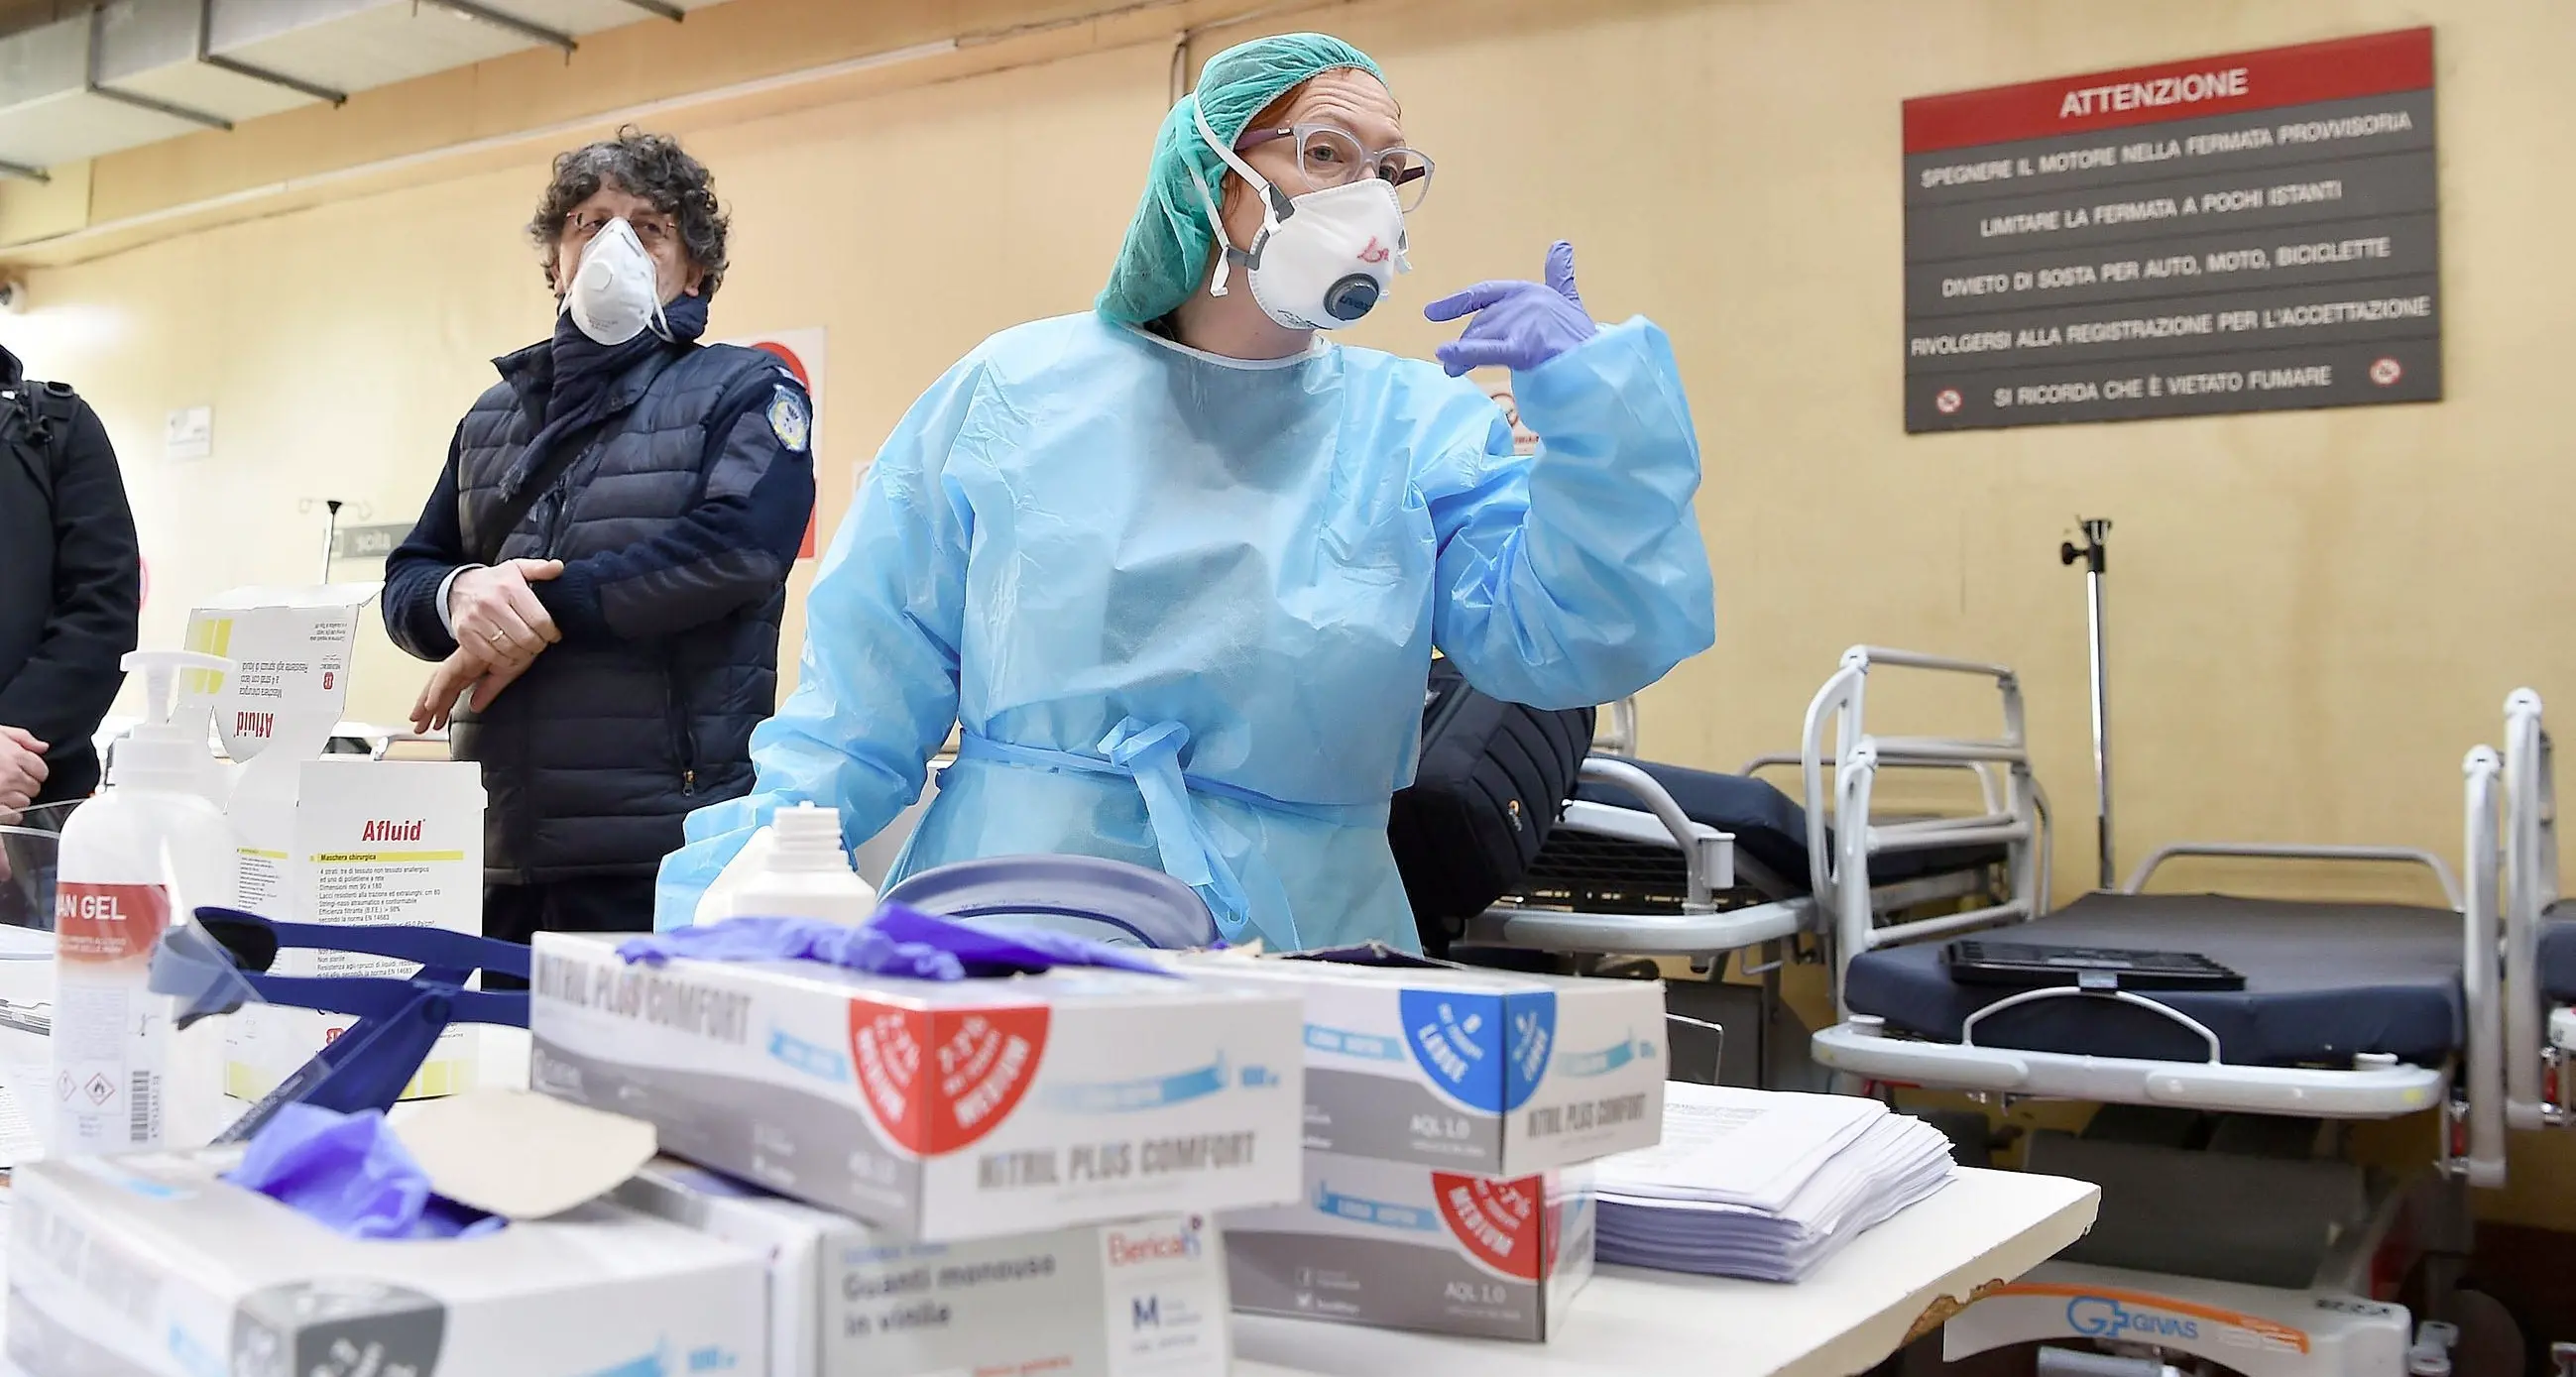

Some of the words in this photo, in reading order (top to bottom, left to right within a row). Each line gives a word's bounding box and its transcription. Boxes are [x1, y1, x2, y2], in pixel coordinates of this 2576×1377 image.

[2059, 68, 2249, 118] ATTENZIONE
[1921, 159, 2012, 187] SPEGNERE
[2017, 160, 2034, 175] IL
[2039, 147, 2115, 174] MOTORE
[2122, 139, 2181, 164] NELLA
[2184, 131, 2274, 157] FERMATA
[2278, 112, 2411, 147] PROVVISORIA
[1981, 213, 2058, 238] LIMITARE
[2064, 210, 2089, 228] LA
[2093, 199, 2177, 226] FERMATA
[2182, 197, 2197, 215] A
[2201, 189, 2264, 215] POCHI
[2269, 180, 2342, 205] ISTANTI
[1941, 274, 2008, 297] DIVIETO
[2014, 273, 2033, 291] DI
[2038, 266, 2097, 290] SOSTA
[2101, 262, 2139, 284] PER
[2143, 255, 2202, 280] AUTO,
[2206, 248, 2271, 273] MOTO,
[2275, 237, 2391, 268] BICICLETTE
[1911, 331, 2012, 357] RIVOLGERSI
[2015, 326, 2061, 350] ALLA
[2066, 314, 2213, 344] REGISTRAZIONE
[2217, 311, 2259, 333] PER
[2263, 296, 2431, 329] L'ACCETTAZIONE
[1994, 388, 2013, 408] SI
[2018, 383, 2100, 405] RICORDA
[2103, 378, 2145, 401] CHE
[2149, 371, 2163, 397] È
[2167, 372, 2242, 394] VIETATO
[2247, 366, 2332, 391] FUMARE
[233, 710, 275, 739] Afluid
[361, 819, 423, 842] Afluid
[320, 853, 348, 861] Maschera
[349, 853, 377, 861] chirurgica
[80, 895, 127, 920] GEL
[644, 971, 752, 1046] COMFORT
[1418, 1022, 1469, 1084] LARGE
[953, 1033, 1031, 1129] MEDIUM
[1068, 1141, 1132, 1182] PLUS
[1141, 1130, 1256, 1176] COMFORT
[1449, 1186, 1516, 1258] MEDIUM
[842, 1262, 932, 1301] Guanti
[937, 1253, 1056, 1291] monouso
[844, 1315, 872, 1339] in
[878, 1303, 952, 1333] vinile
[1132, 1295, 1162, 1330] M
[2131, 1314, 2199, 1340] GIVAS
